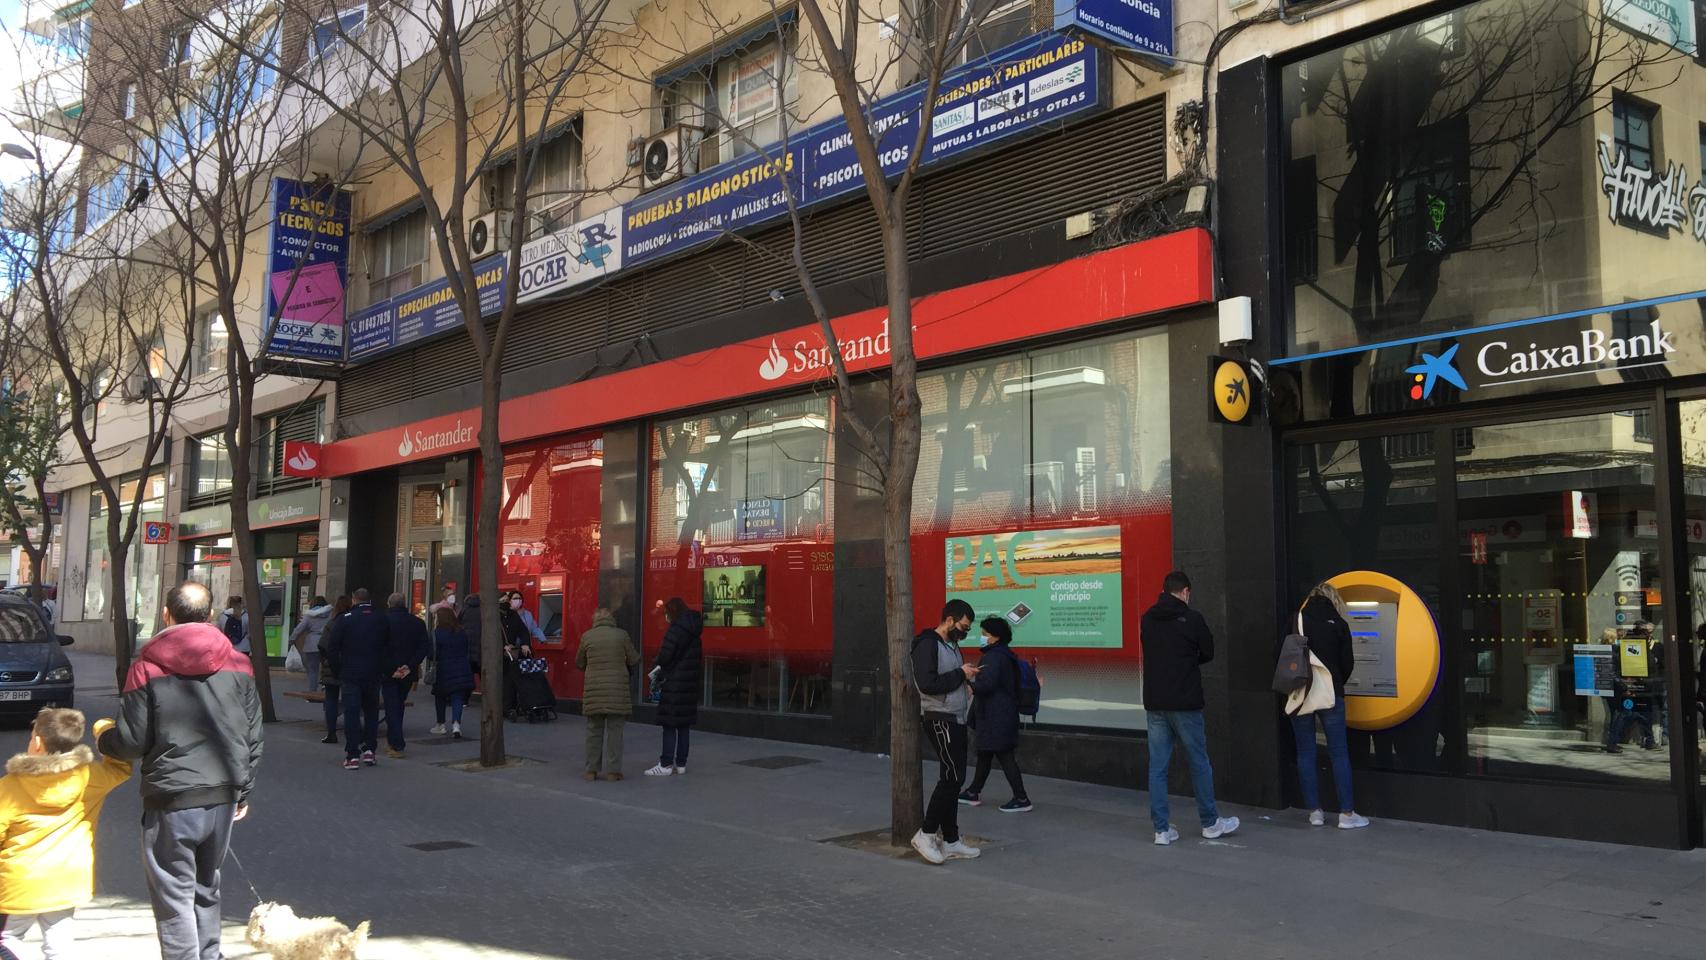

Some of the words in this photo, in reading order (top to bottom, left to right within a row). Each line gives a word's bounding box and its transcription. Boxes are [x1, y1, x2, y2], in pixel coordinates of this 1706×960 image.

[1080, 9, 1104, 27] Horario
[1105, 22, 1133, 39] continuo
[1134, 34, 1143, 44] de
[1144, 37, 1149, 47] 9
[1155, 43, 1163, 52] 21
[1005, 40, 1085, 80] PARTICULARES
[980, 92, 1010, 113] asisa
[1030, 76, 1064, 96] adeslas
[932, 133, 973, 154] MUTUAS
[976, 109, 1039, 137] LABORALES
[1047, 91, 1086, 112] OTRAS
[933, 110, 962, 131] SANITAS
[820, 129, 855, 156] CLINIC
[820, 146, 909, 189] PSICOTICOS
[628, 196, 682, 230] PRUEBAS
[687, 153, 793, 209] DIAGNOSTICAS
[280, 212, 344, 237] TECNCOS
[628, 232, 672, 257] RADIOLOGIA
[678, 214, 722, 240] ECOGRAFIA
[731, 196, 769, 221] ANALISIS
[281, 250, 315, 261] ARMS
[282, 236, 339, 253] CONDCTOR
[521, 245, 539, 264] NTRO
[540, 234, 569, 256] MEDICO
[517, 256, 568, 291] OCAR
[399, 286, 458, 318] ESPECIALIDAD
[474, 267, 503, 290] DICAS
[793, 317, 918, 373] Santand
[1477, 320, 1677, 377] CaixaBank
[415, 420, 474, 453] Santander
[951, 531, 1034, 586] PAC
[1050, 580, 1079, 593] Contigo
[1080, 579, 1103, 589] desde
[1050, 593, 1057, 601] el
[1058, 591, 1091, 603] principio
[12, 691, 30, 700] BHP
